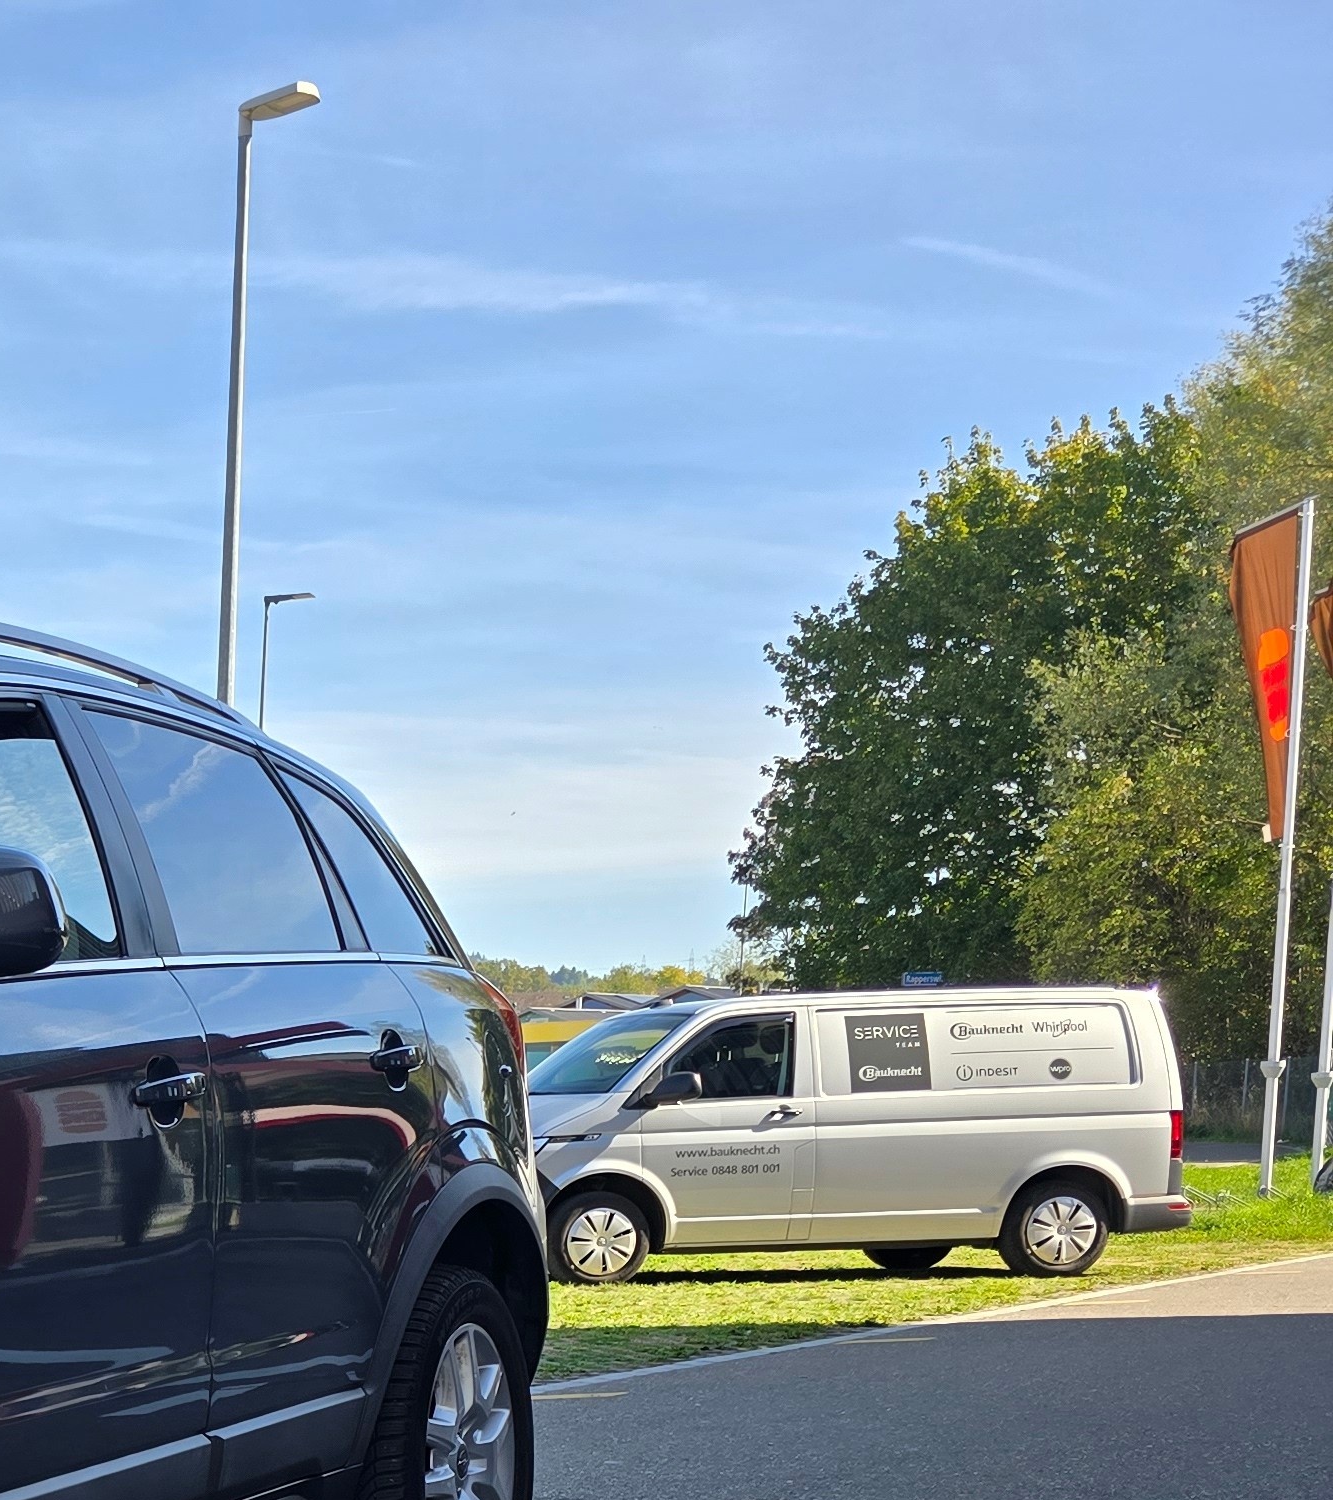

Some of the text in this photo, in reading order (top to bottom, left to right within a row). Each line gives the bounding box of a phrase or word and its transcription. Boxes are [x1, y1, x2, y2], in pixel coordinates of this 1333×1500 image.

[854, 1024, 919, 1041] SERVICE
[950, 1022, 1024, 1041] Bauknecht
[1031, 1019, 1088, 1038] Whirlpool
[858, 1065, 922, 1082] Bauknecht
[675, 1144, 781, 1158] www.bauknecht.ch
[670, 1163, 780, 1177] Service 0848 801 001
